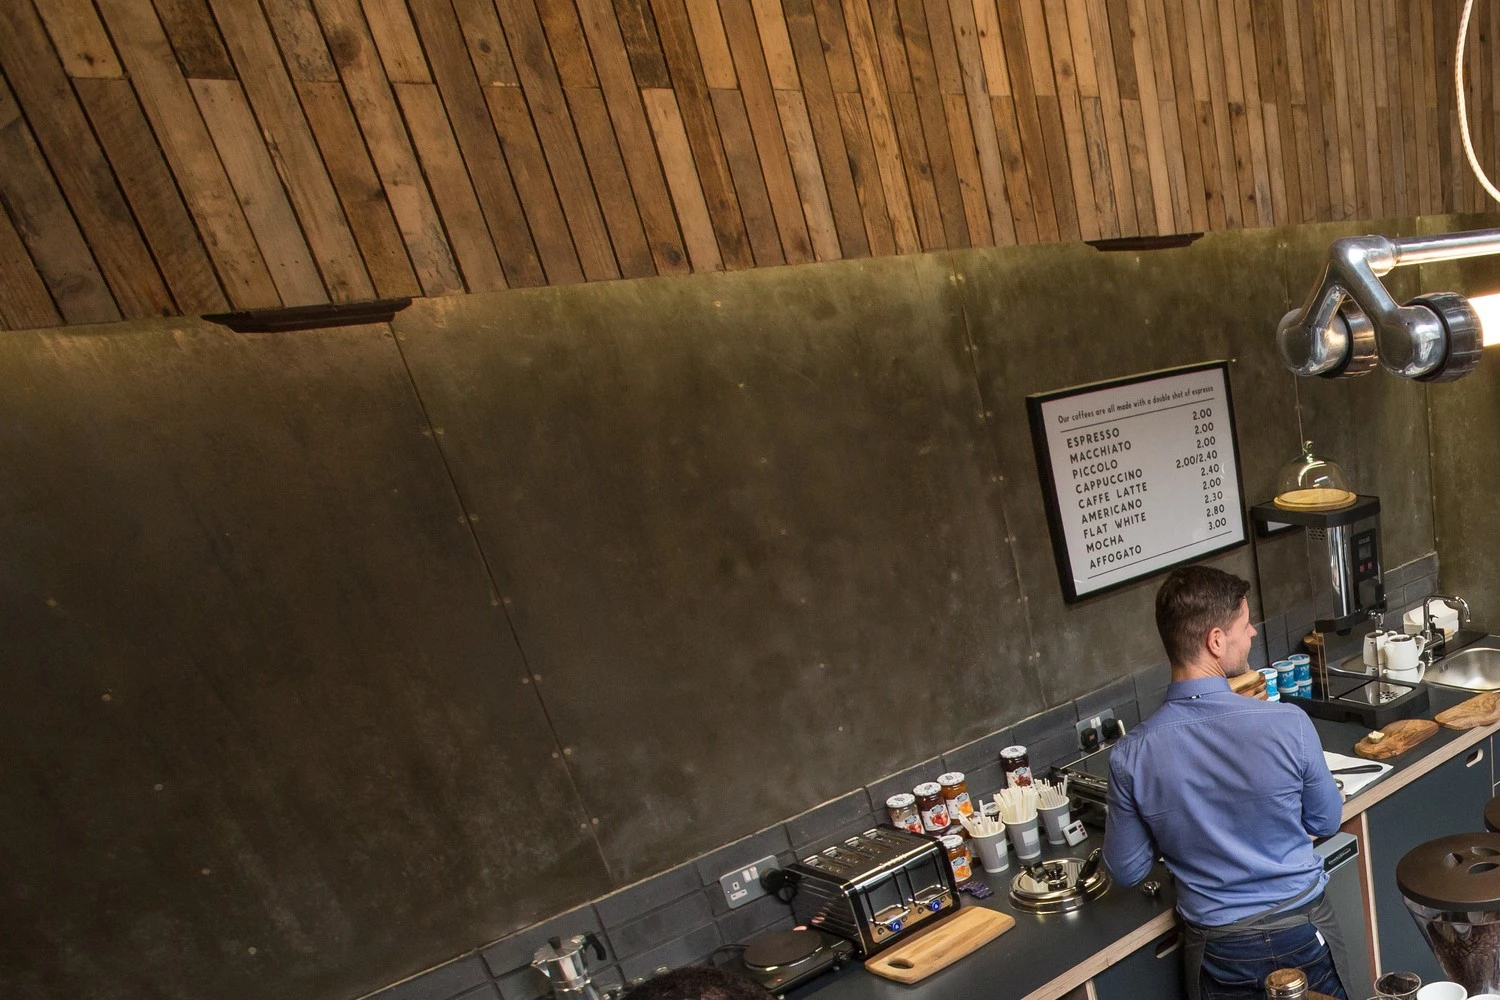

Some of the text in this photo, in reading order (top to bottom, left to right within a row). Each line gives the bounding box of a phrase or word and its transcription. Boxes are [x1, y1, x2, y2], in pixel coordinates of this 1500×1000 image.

[1058, 415, 1070, 424] Our
[1072, 410, 1094, 421] coffees
[1096, 407, 1106, 416] are
[1107, 404, 1115, 414] all
[1116, 401, 1132, 411] made
[1133, 397, 1146, 408] with
[1152, 393, 1170, 404] double
[1171, 390, 1184, 399] shot
[1185, 388, 1191, 397] of
[1192, 385, 1214, 396] espresso
[1067, 408, 1212, 448] ESPRESSO 2.00
[1070, 423, 1214, 464] MACCHIATO 2.00
[1072, 437, 1216, 479] PICCOLO 2.00
[1075, 451, 1218, 494] CAPPUCCINO 2.00/2.40
[1078, 464, 1219, 509] CAFFE LATTE 2.40
[1081, 478, 1221, 524] AMERICANO 2.00
[1084, 491, 1223, 539] FLAT WHITE 2.30
[1086, 505, 1225, 553] MOCHA 2.80
[1090, 518, 1226, 569] AFFOGATO 3.00
